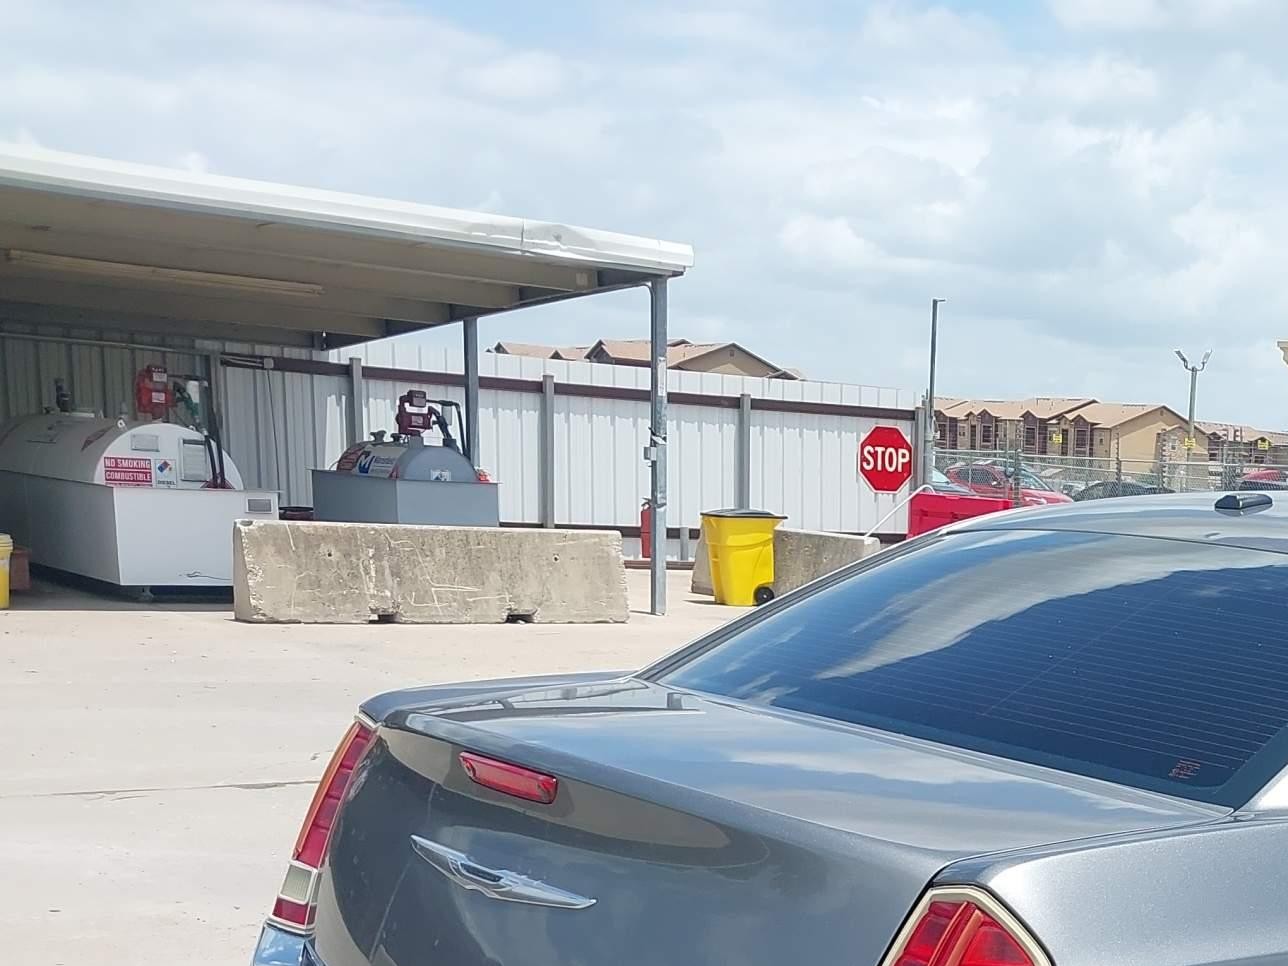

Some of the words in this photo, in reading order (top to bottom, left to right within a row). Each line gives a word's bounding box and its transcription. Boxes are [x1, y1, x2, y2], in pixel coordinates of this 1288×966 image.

[105, 458, 116, 468] NO
[117, 459, 151, 469] SMOKING
[862, 445, 910, 473] STOP
[106, 471, 152, 481] COMBUSTIBLE
